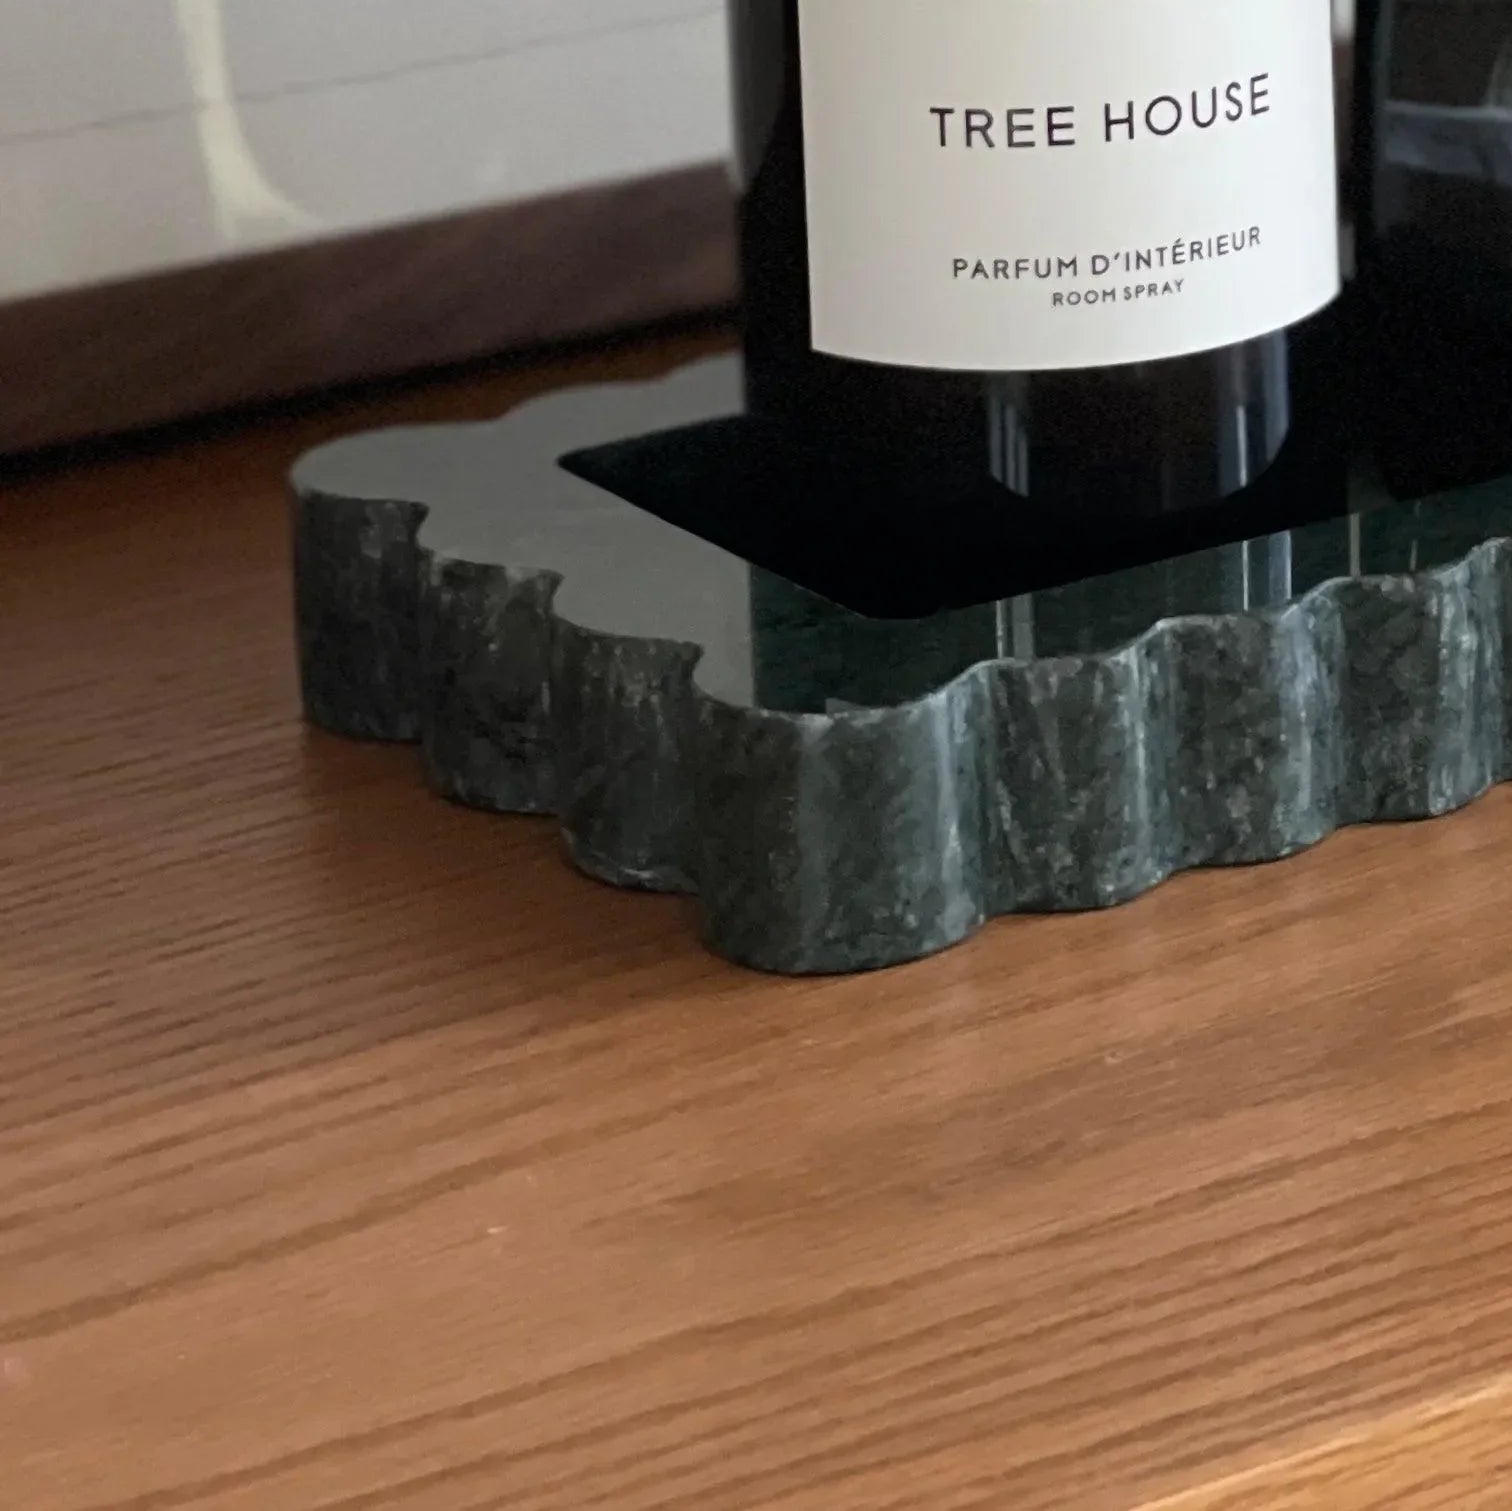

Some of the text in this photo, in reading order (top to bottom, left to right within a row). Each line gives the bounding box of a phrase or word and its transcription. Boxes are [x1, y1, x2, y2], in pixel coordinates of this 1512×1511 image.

[928, 72, 1271, 148] TREE HOUSE
[952, 226, 1261, 280] PARFUM D'INTÉRIEUR
[1052, 279, 1185, 307] ROOM SPRAY
